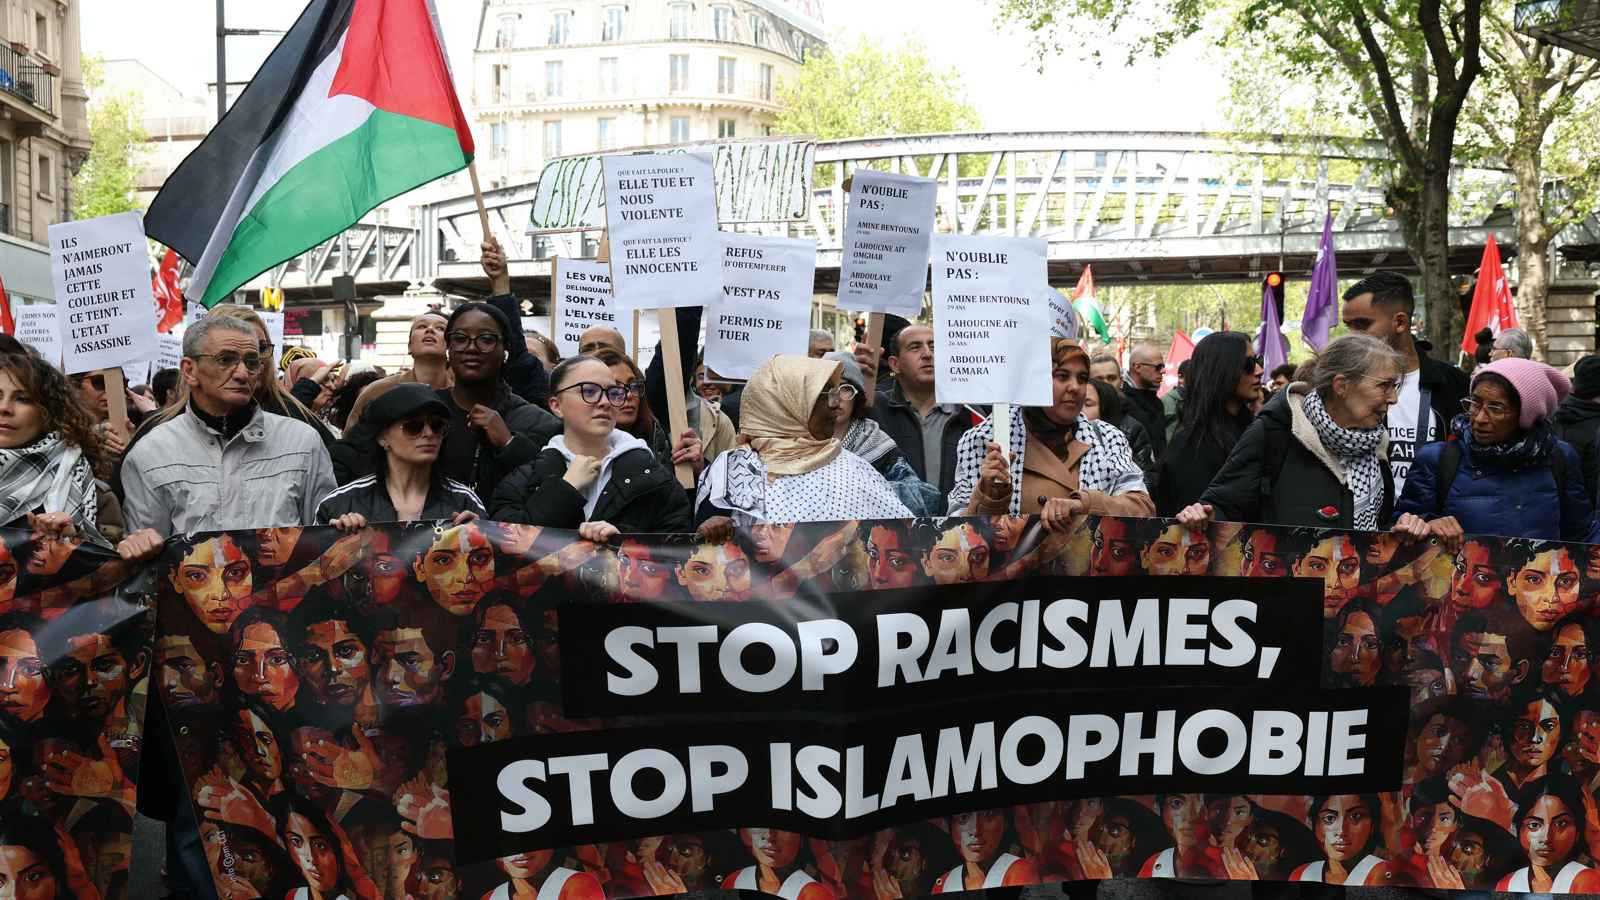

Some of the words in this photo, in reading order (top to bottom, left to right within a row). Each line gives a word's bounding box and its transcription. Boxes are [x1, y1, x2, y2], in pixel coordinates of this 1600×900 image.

[619, 178, 648, 190] ELLE
[651, 177, 676, 188] TUE
[679, 176, 695, 187] ET
[861, 184, 909, 199] N'OUBLIE
[620, 194, 654, 205] NOUS
[860, 199, 880, 210] PAS
[621, 207, 684, 221] VIOLENTE
[857, 221, 880, 231] AMINE
[880, 223, 920, 234] BENTOUNSI
[61, 237, 78, 249] ILS
[663, 236, 687, 244] JUSTICE
[854, 241, 893, 252] LAHOUCINE
[62, 243, 132, 264] N'AIMERONT
[626, 248, 656, 259] ELLE
[659, 247, 681, 258] LES
[726, 247, 763, 259] REFUS
[853, 251, 883, 260] OMGHAR
[946, 251, 1008, 264] N'OUBLIE
[64, 263, 103, 281] JAMAIS
[625, 261, 698, 275] INNOCENTE
[946, 267, 972, 279] PAS
[566, 271, 586, 281] LES
[589, 274, 611, 284] VRA
[850, 271, 892, 281] ABDOULAYE
[66, 279, 101, 294] CETTE
[565, 284, 612, 295] DELINQUANT
[849, 281, 878, 290] CAMARA
[68, 291, 119, 309] COULEUR
[122, 288, 136, 300] ET
[722, 285, 755, 298] N'EST
[758, 289, 781, 300] PAS
[566, 295, 595, 305] SONT
[947, 294, 977, 303] AMINE
[979, 295, 1030, 305] BENTOUNSI
[70, 312, 83, 324] CE
[85, 307, 122, 321] TEINT.
[720, 315, 764, 328] PERMIS
[767, 319, 783, 330] DE
[948, 319, 1001, 328] LAHOUCINE
[72, 324, 109, 339] L'ETAT
[718, 329, 750, 341] TUER
[948, 330, 990, 339] OMGHAR
[74, 336, 132, 354] ASSASSINE
[949, 355, 1006, 363] ABDOULAYE
[950, 367, 989, 375] CAMARA
[1388, 427, 1415, 439] TICE
[604, 618, 858, 697] STOP
[876, 598, 1281, 688] RACISMES,
[496, 744, 749, 833] STOP
[770, 709, 1369, 819] ISLAMOPHOBIE
